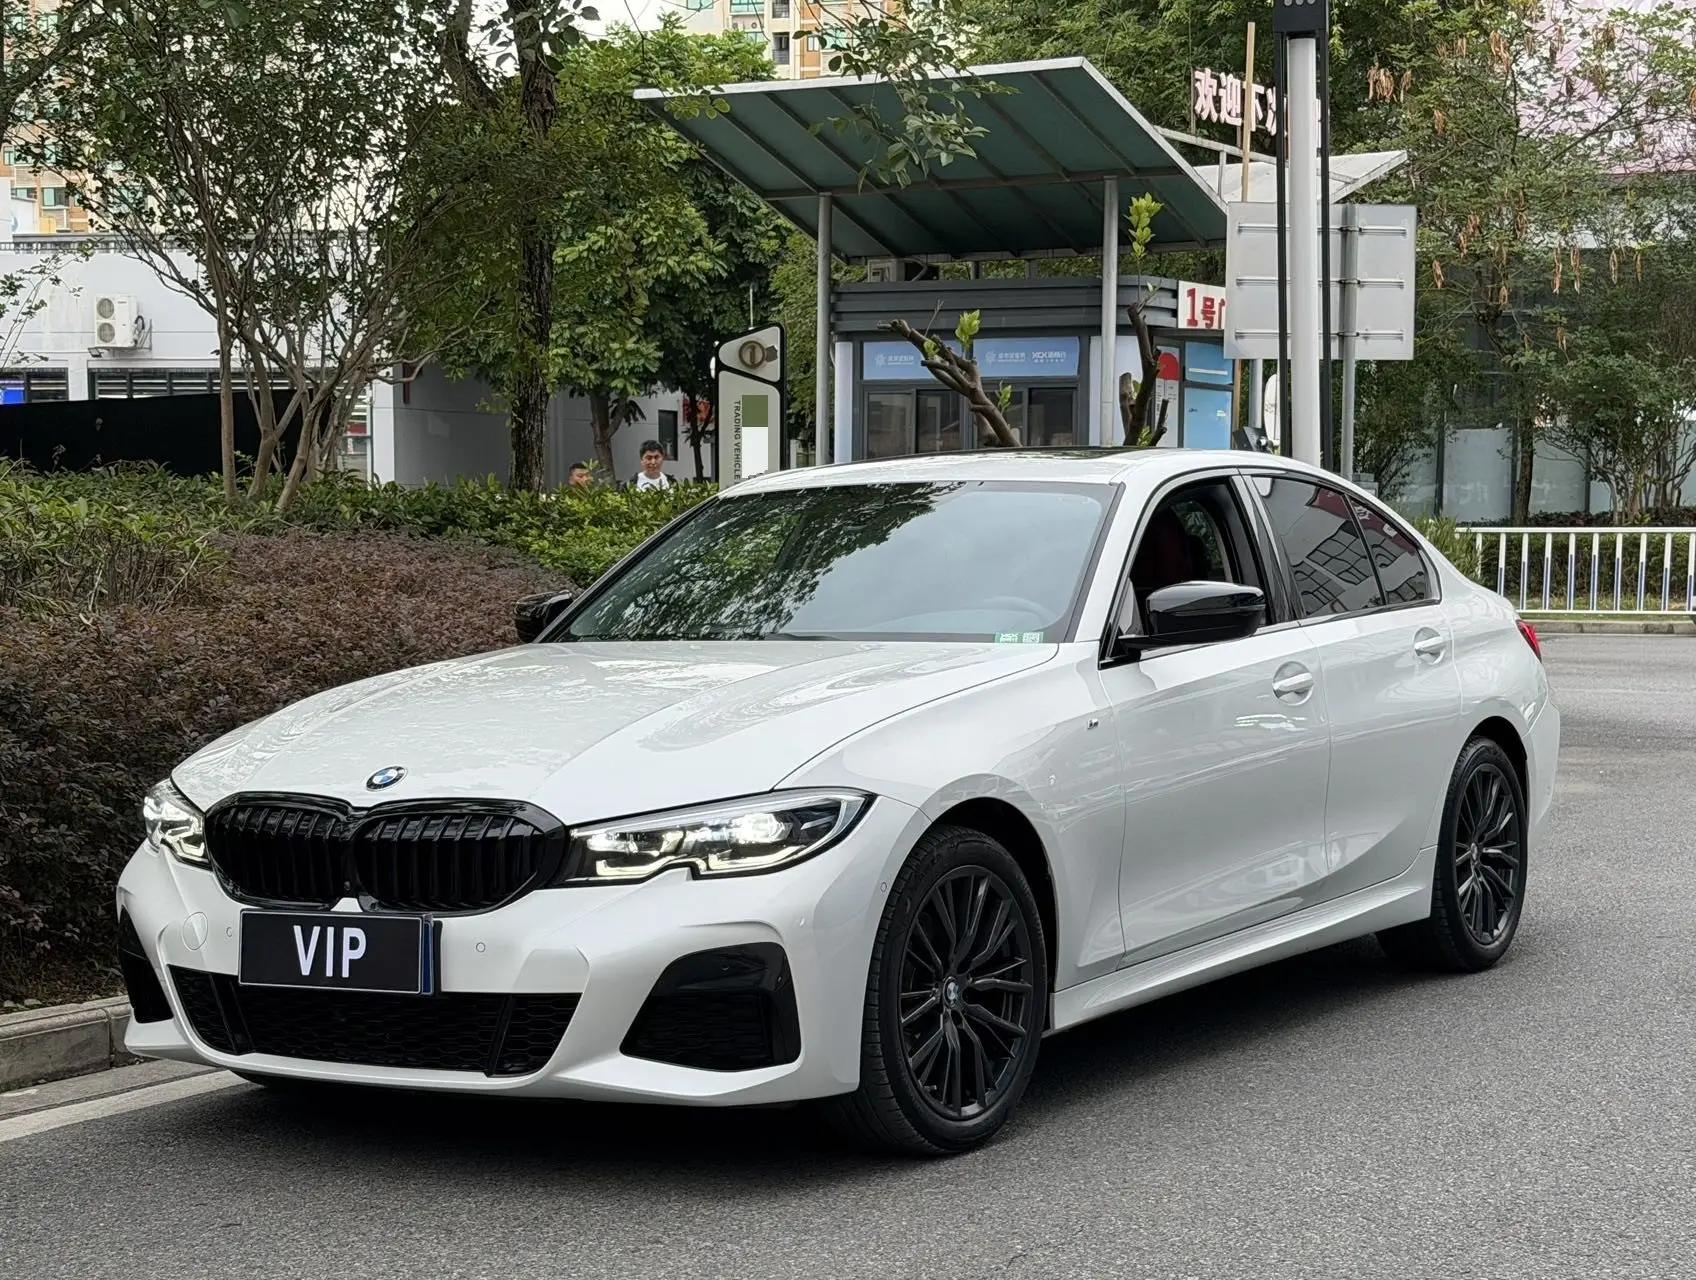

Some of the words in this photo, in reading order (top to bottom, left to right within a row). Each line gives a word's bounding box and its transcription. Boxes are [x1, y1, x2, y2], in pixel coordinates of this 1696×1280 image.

[734, 401, 742, 440] TRADING
[734, 442, 742, 480] VEHICLE
[293, 924, 367, 978] VIP
